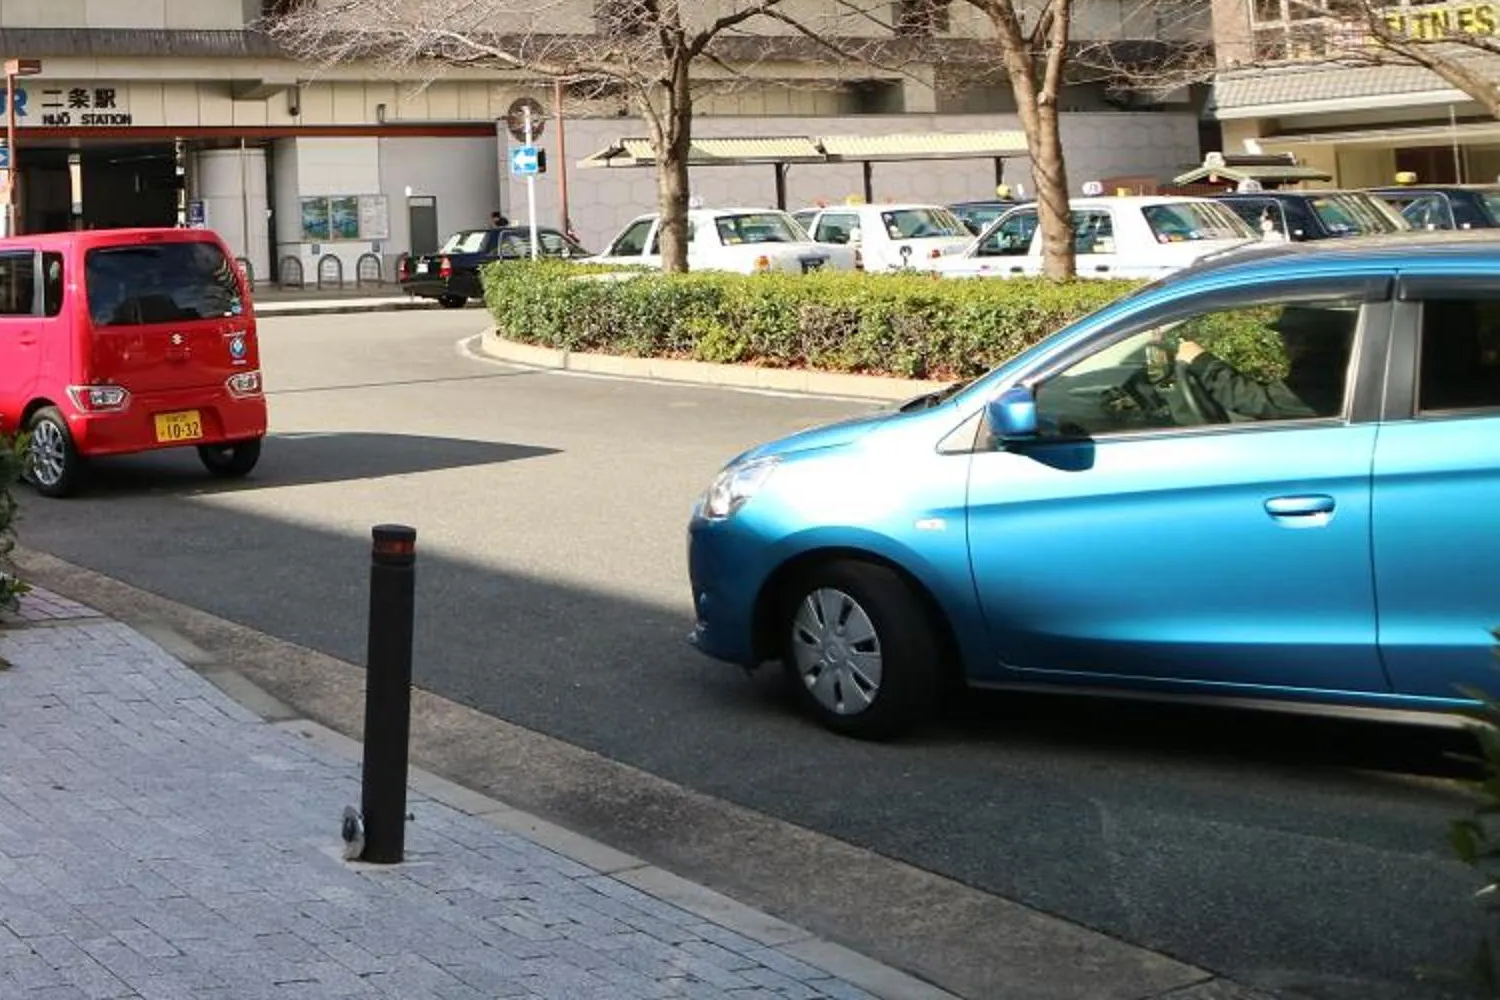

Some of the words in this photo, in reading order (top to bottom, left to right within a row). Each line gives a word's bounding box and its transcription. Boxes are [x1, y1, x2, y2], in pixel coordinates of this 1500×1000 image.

[42, 87, 117, 109] 二条駅
[80, 113, 132, 125] STATION
[166, 421, 199, 439] 10-32
